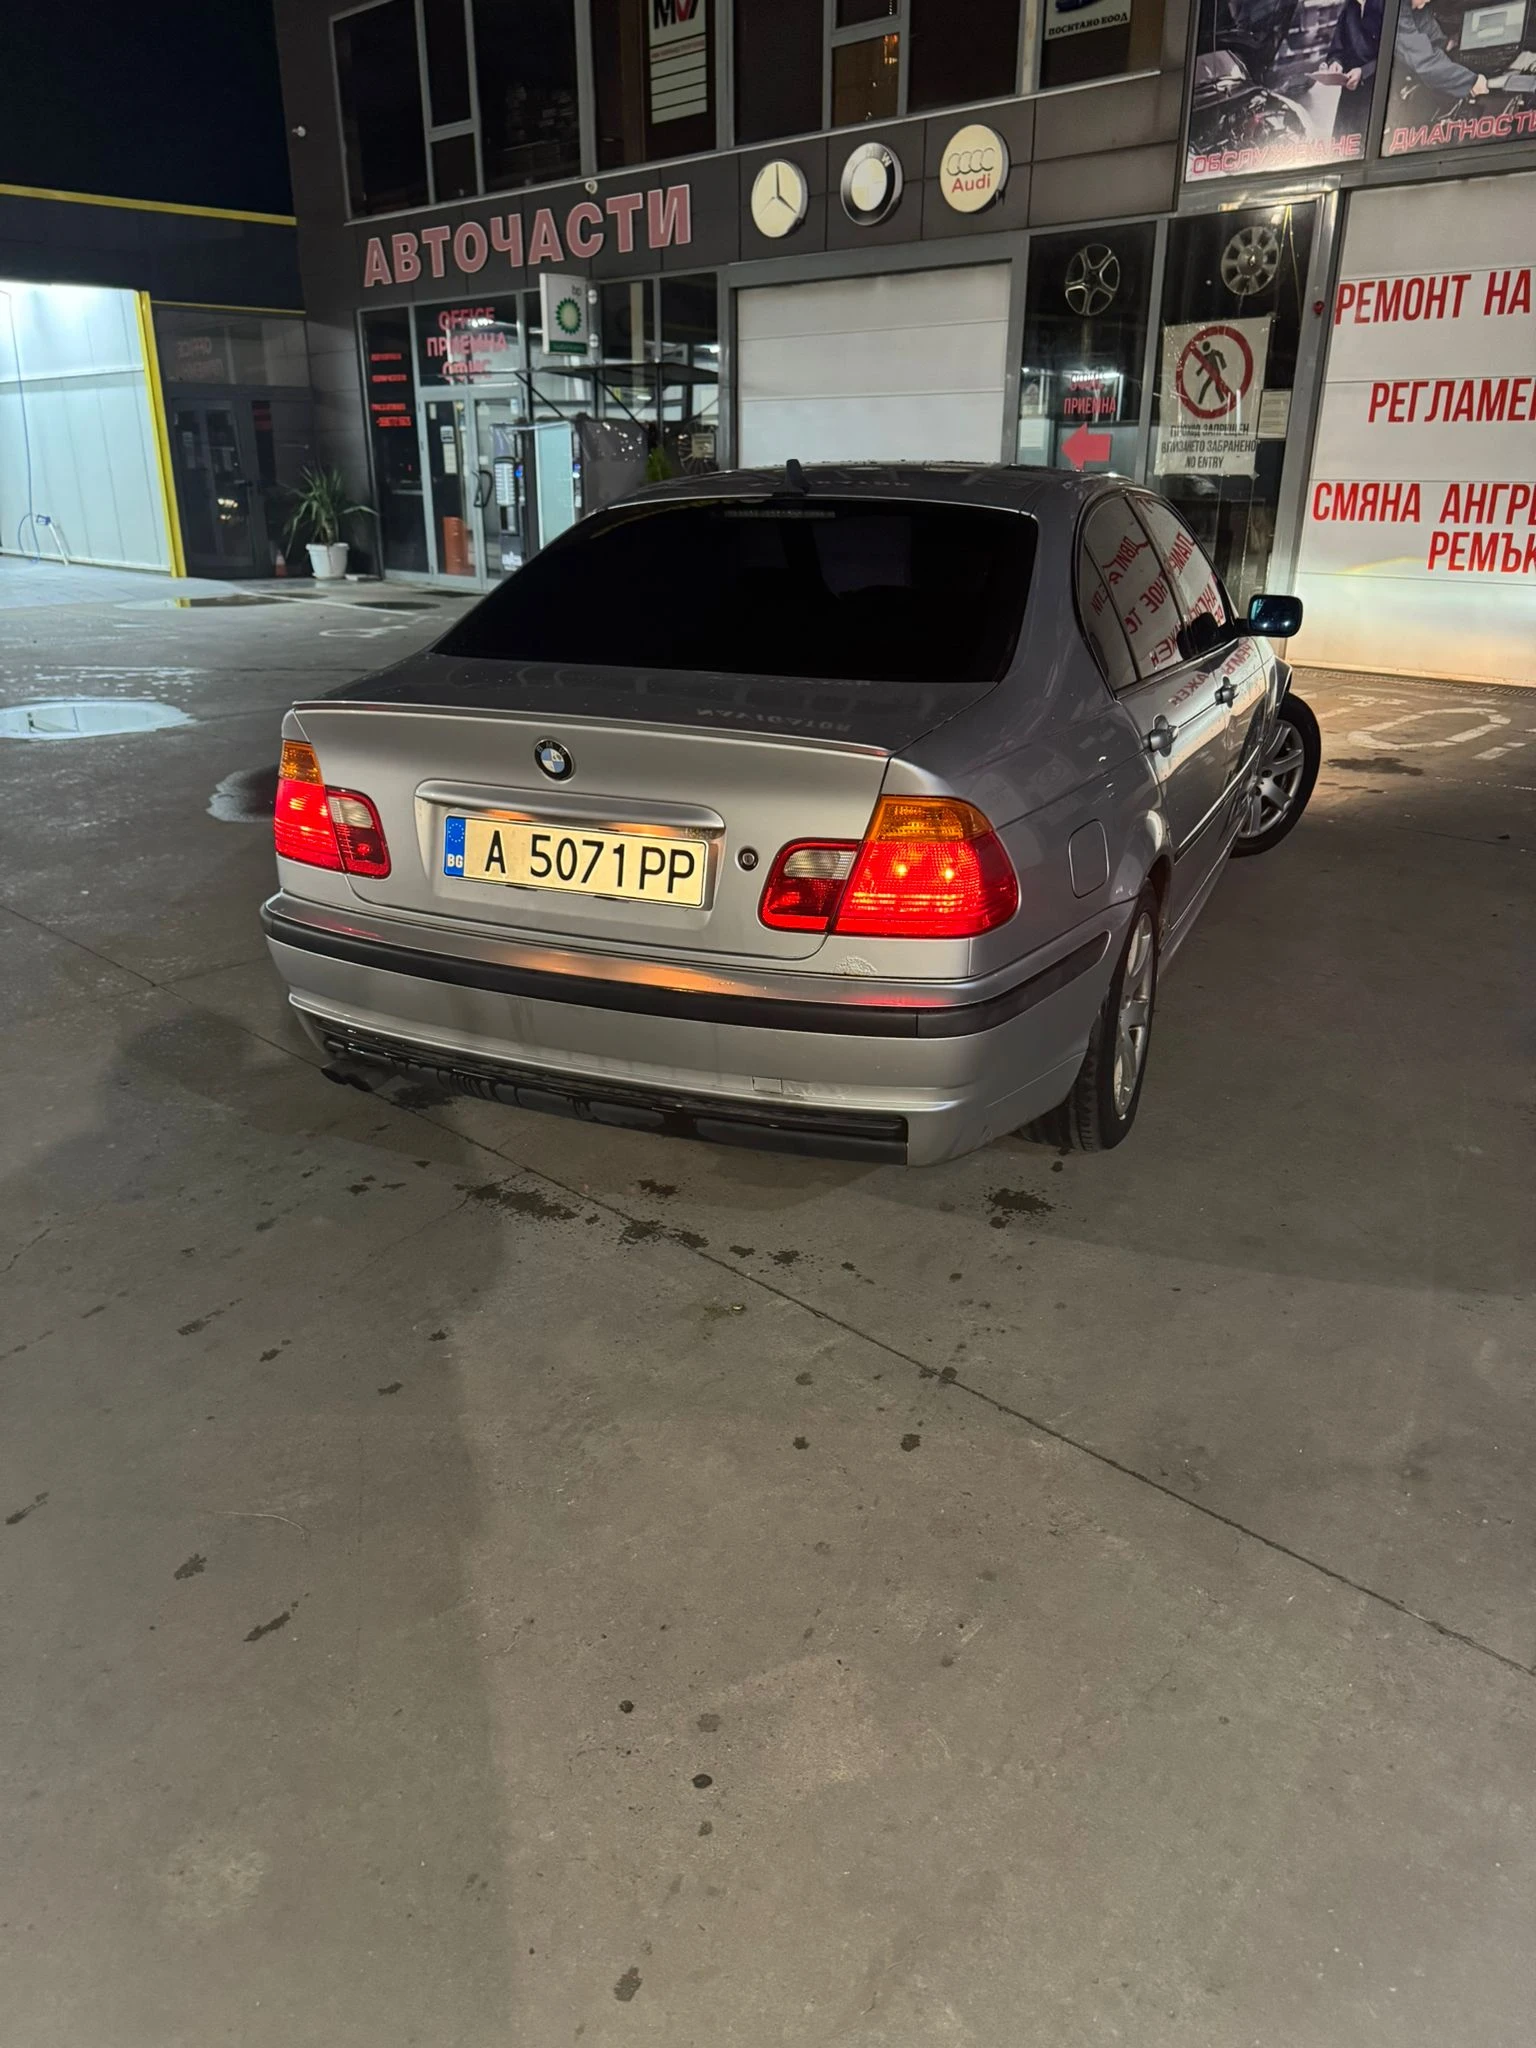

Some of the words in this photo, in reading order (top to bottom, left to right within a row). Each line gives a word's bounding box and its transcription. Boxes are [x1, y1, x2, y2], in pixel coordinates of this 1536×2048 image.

[951, 173, 991, 193] Audi
[363, 184, 691, 288] АВТОЧАСТИ
[1334, 274, 1472, 325] РЕМОНТ
[1483, 269, 1532, 316] НА
[1063, 396, 1116, 416] ПРИЕМНА
[1206, 438, 1257, 452] ЗАБРАНЕНО
[1185, 456, 1196, 468] NO
[1197, 456, 1224, 468] ENTRY
[1312, 482, 1420, 523] СМЯНА
[447, 853, 463, 868] BG
[484, 830, 506, 874] A
